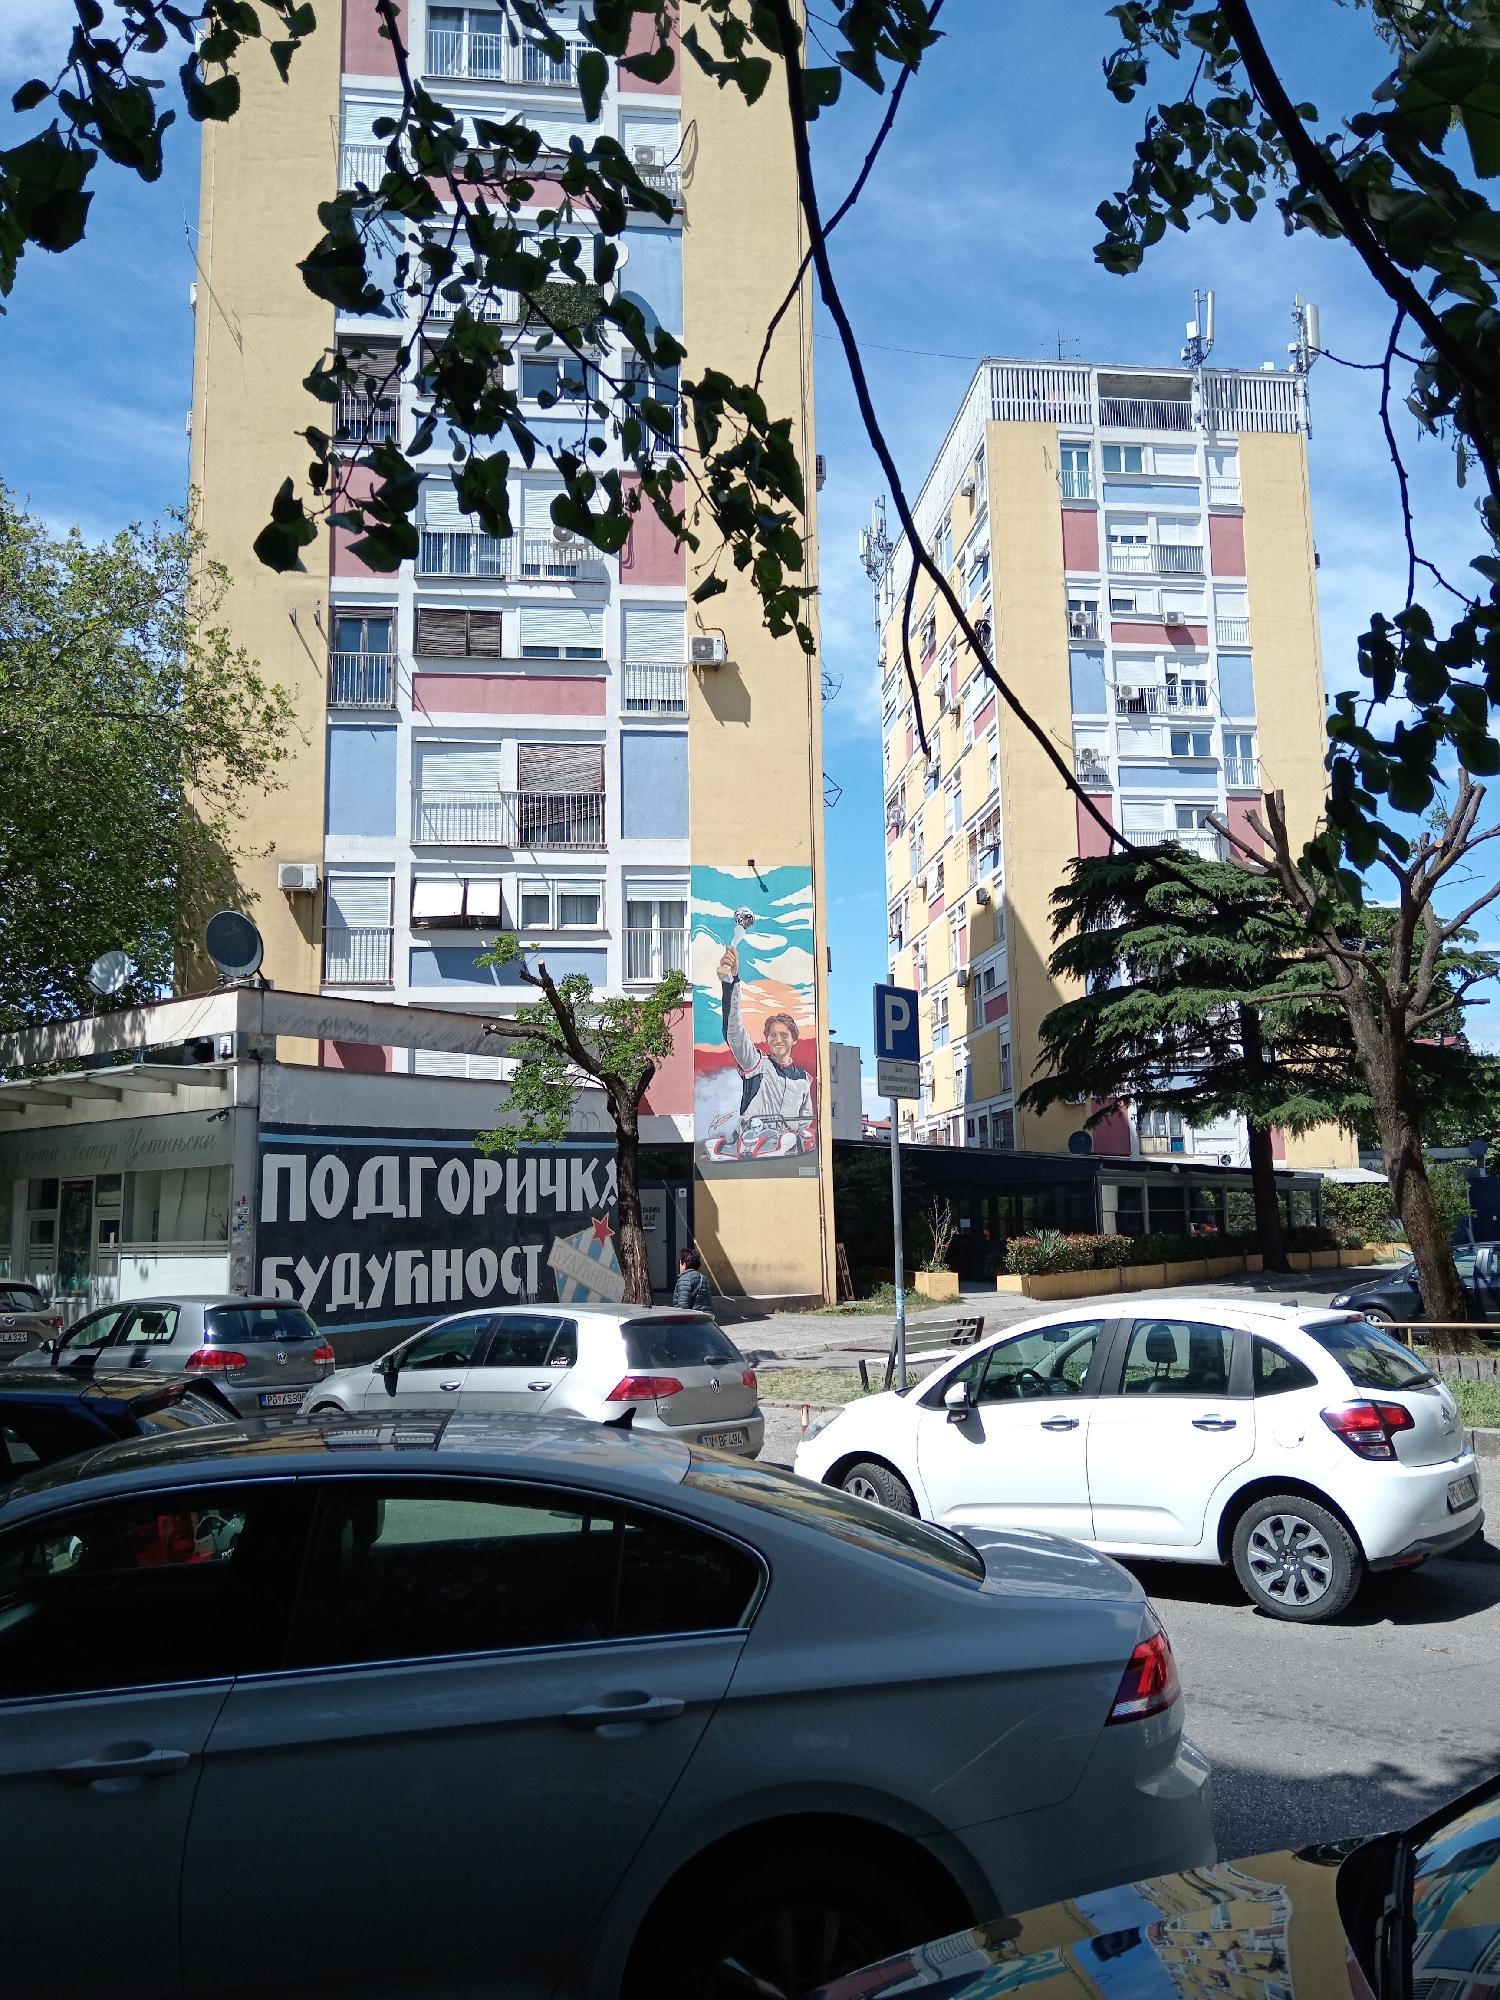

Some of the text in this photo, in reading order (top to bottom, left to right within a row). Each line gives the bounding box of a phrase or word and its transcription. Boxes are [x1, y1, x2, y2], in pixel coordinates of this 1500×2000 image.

[885, 994, 911, 1051] P
[124, 1128, 217, 1167] Цетињски
[261, 1153, 619, 1222] ПОДГОРИЧКА
[261, 1245, 544, 1312] БУДУЋНОСТ
[553, 1244, 623, 1297] БУДУЋНОСТ
[267, 1395, 278, 1405] PG
